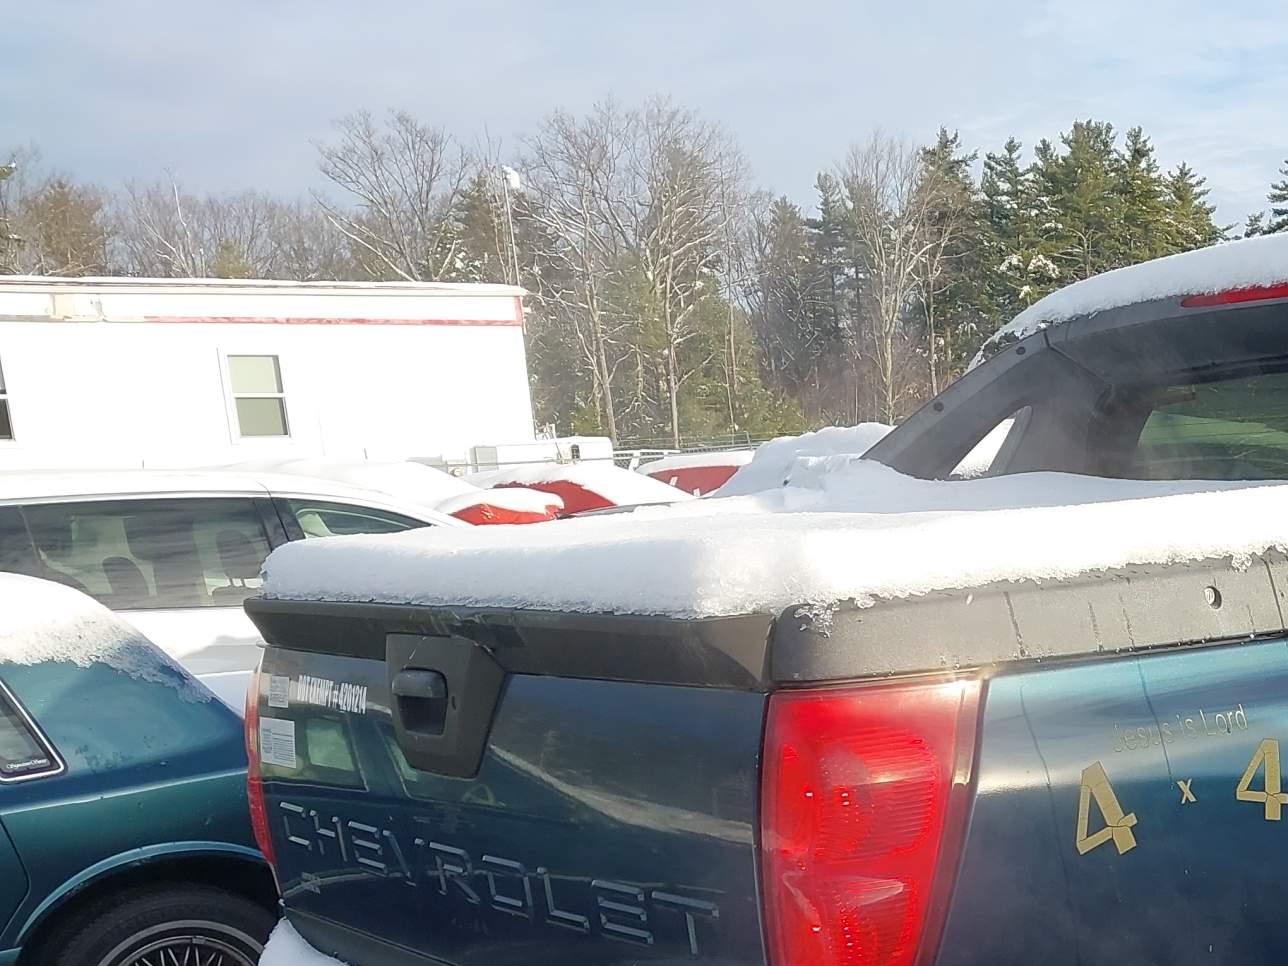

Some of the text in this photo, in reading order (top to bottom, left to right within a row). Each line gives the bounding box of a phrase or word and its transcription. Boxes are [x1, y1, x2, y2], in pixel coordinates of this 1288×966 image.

[1112, 703, 1248, 753] Jesus is Lord
[1076, 760, 1138, 855] 4
[1236, 737, 1288, 821] 4
[280, 801, 720, 955] CHEVROLET
